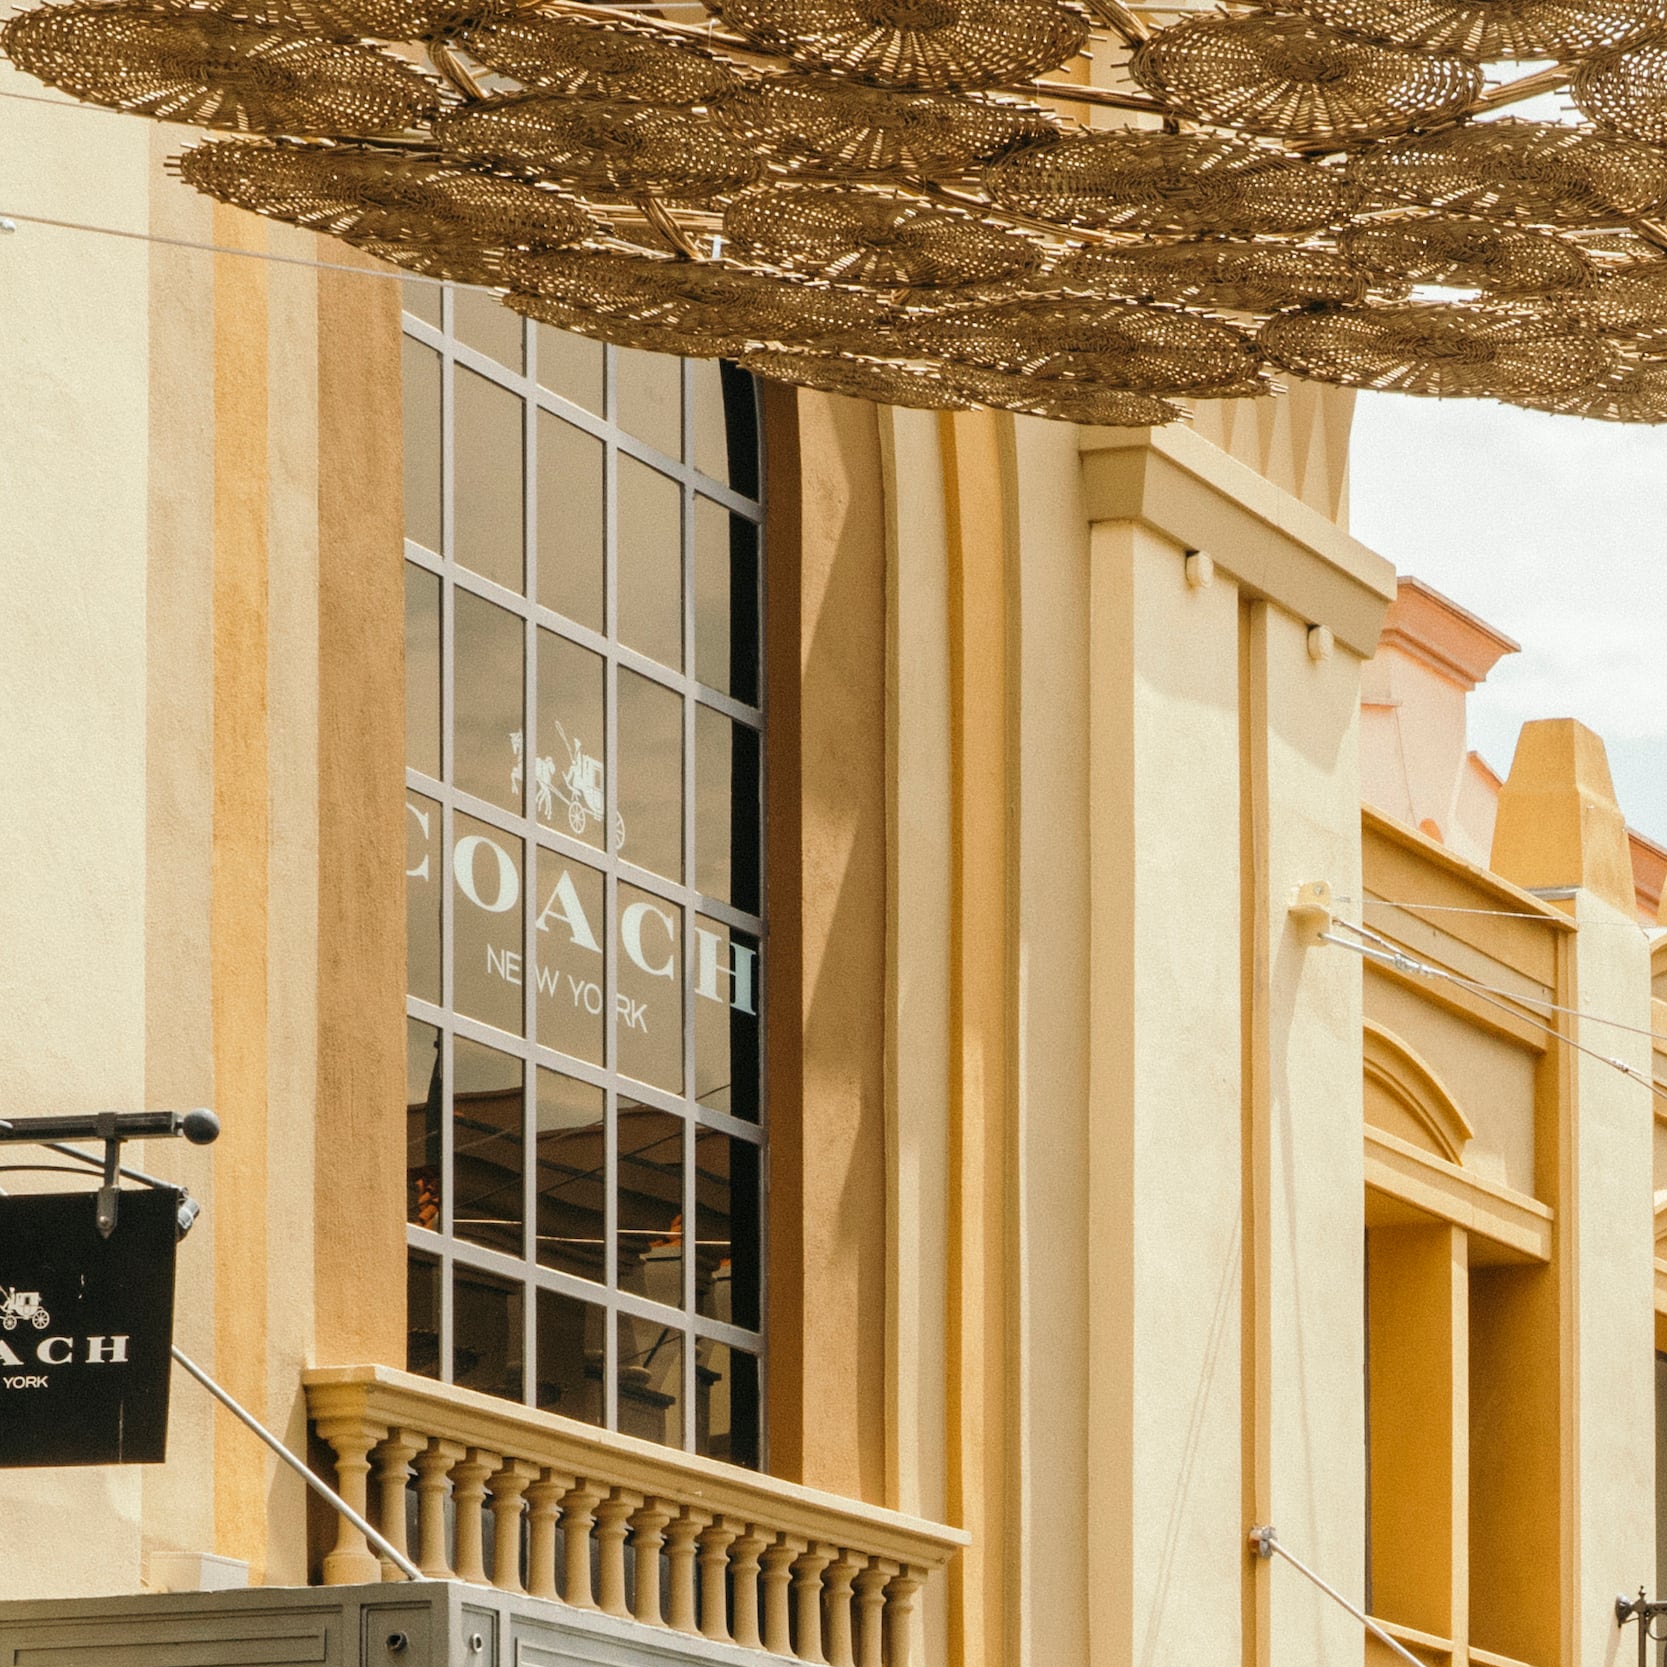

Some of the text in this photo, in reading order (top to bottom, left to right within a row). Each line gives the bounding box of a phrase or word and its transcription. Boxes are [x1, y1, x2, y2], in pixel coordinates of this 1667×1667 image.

[486, 943, 649, 1033] NEW YORK
[2, 1376, 49, 1389] YORK
